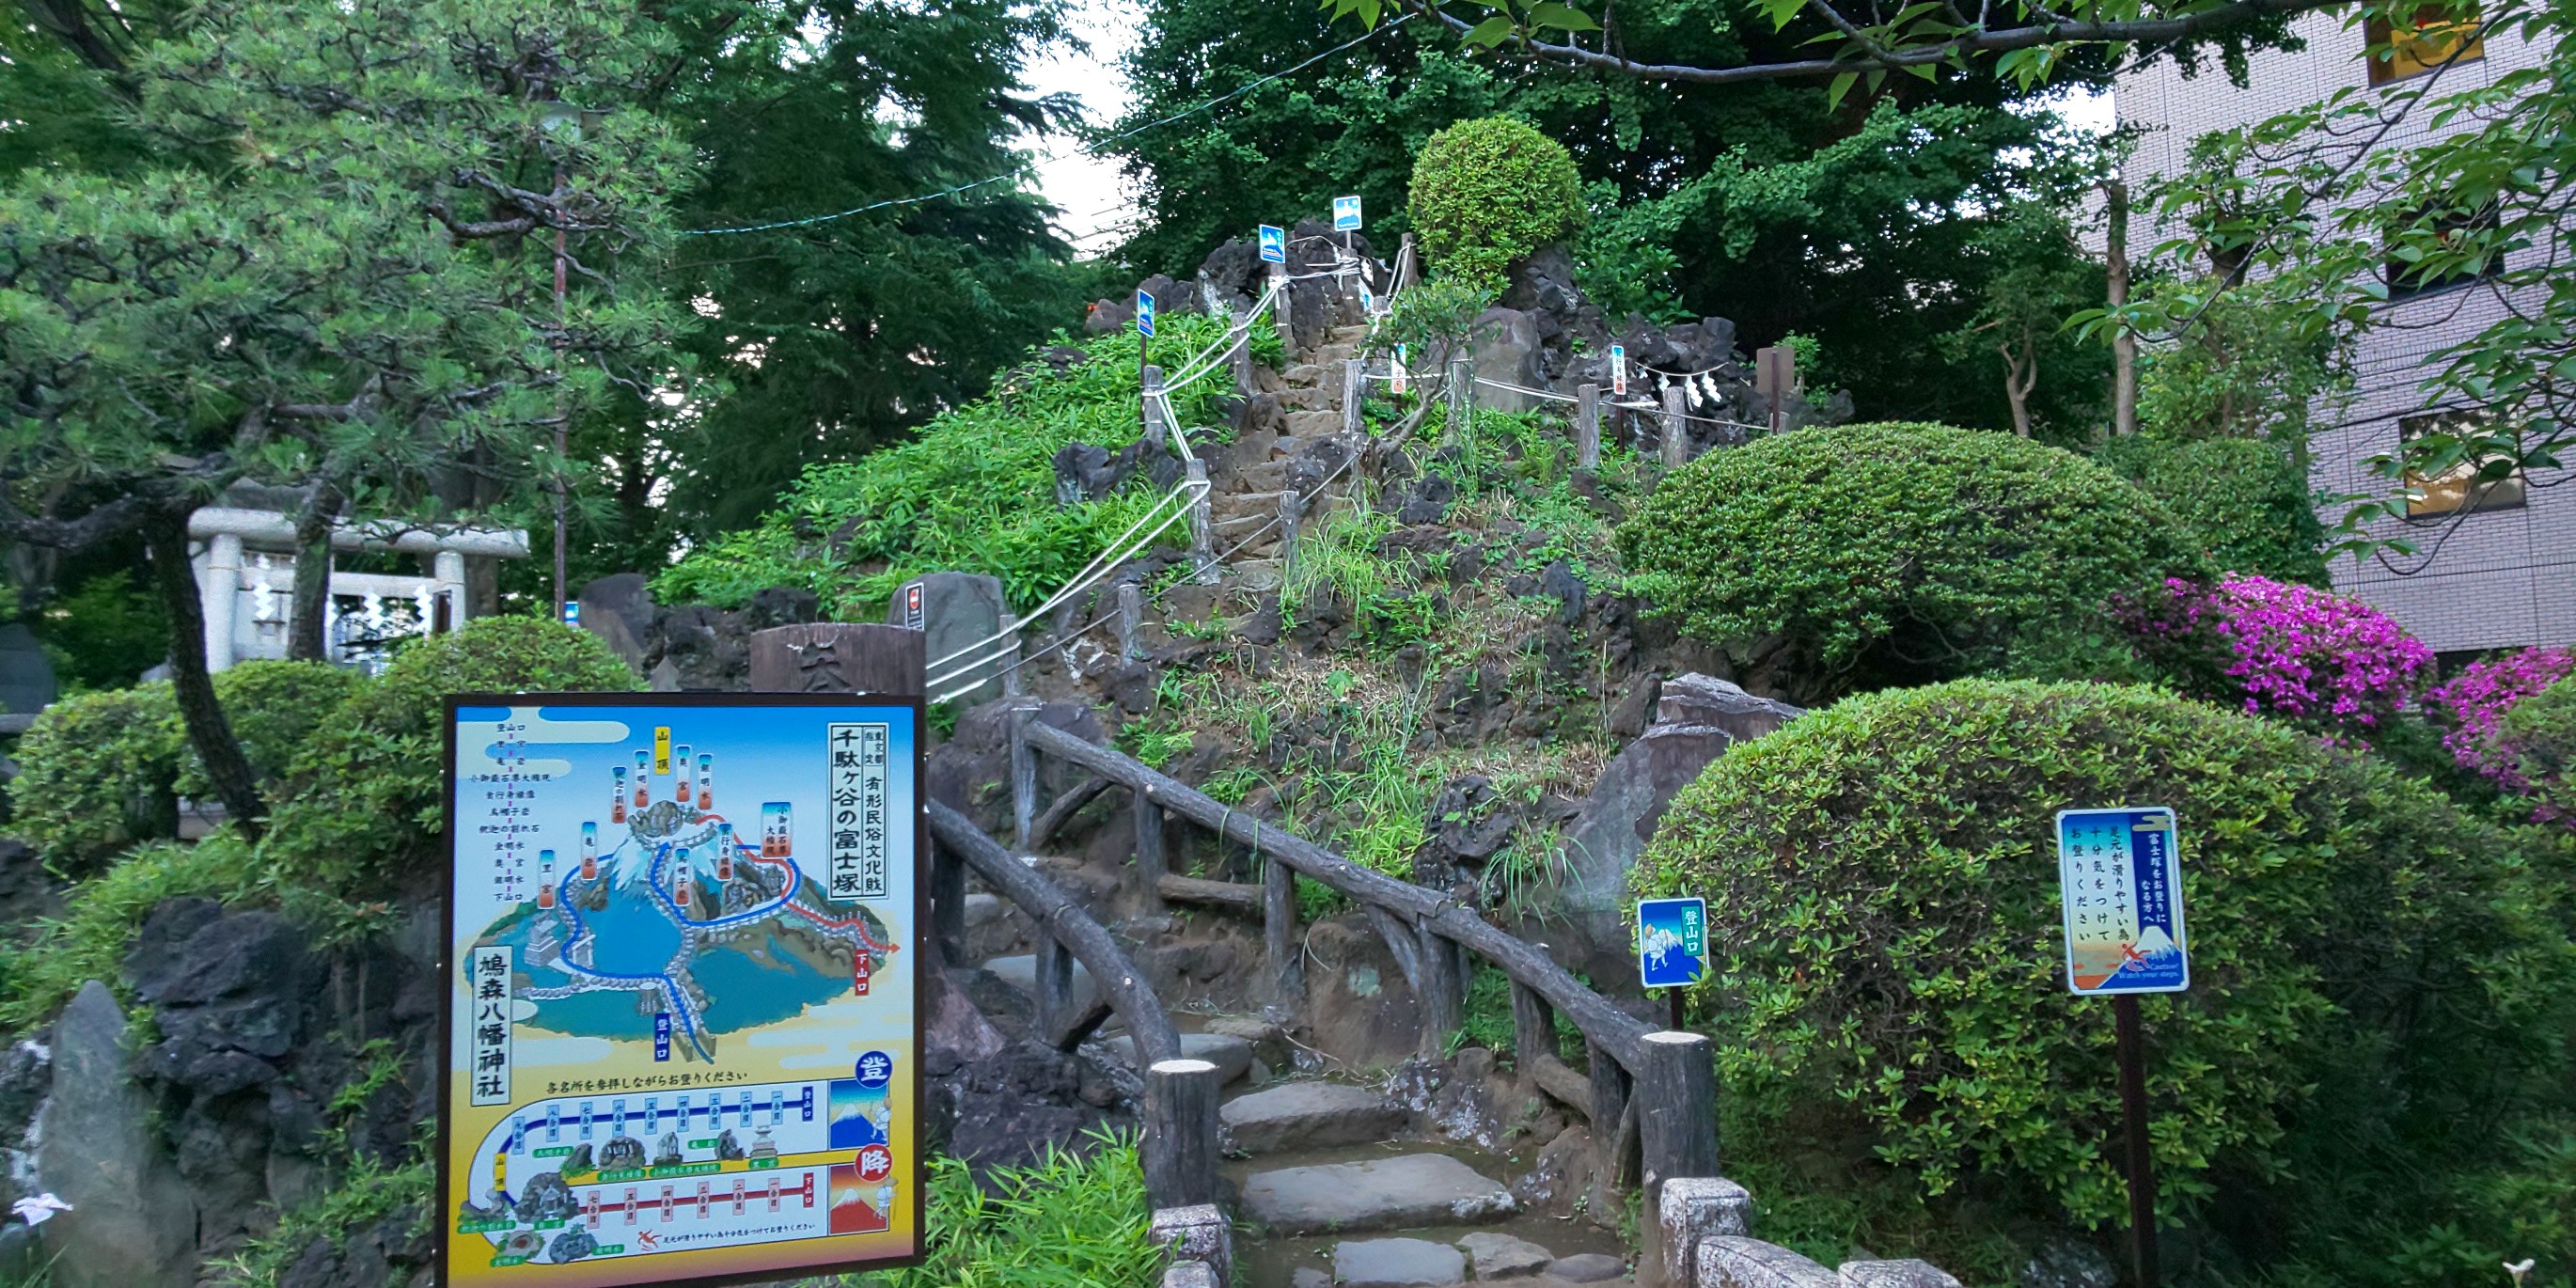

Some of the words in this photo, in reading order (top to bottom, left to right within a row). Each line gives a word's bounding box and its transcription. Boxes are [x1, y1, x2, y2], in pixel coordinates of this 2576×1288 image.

[496, 724, 526, 732] 登山口
[657, 731, 668, 770] 山頂
[874, 731, 884, 765] 東京都
[865, 776, 882, 892] 有形民俗文化財
[2071, 827, 2090, 940] お登りください
[2090, 826, 2110, 940] 十分気をつけて
[2148, 833, 2166, 922] 富士塚をお登りに
[494, 893, 523, 902] 下山口
[2142, 880, 2155, 922] なる方へ
[1685, 910, 1698, 952] 登山口
[856, 952, 868, 992] 下山口
[477, 953, 508, 1098] 鳩森八幡神社
[656, 1018, 668, 1059] 登山口
[546, 1070, 748, 1094] 各名所を参拝しながらお登りください
[860, 1057, 888, 1082] 登
[582, 1107, 590, 1134] 七合目
[804, 1091, 812, 1118] 登山口
[495, 1158, 504, 1186] 山頂
[861, 1151, 889, 1176] 降
